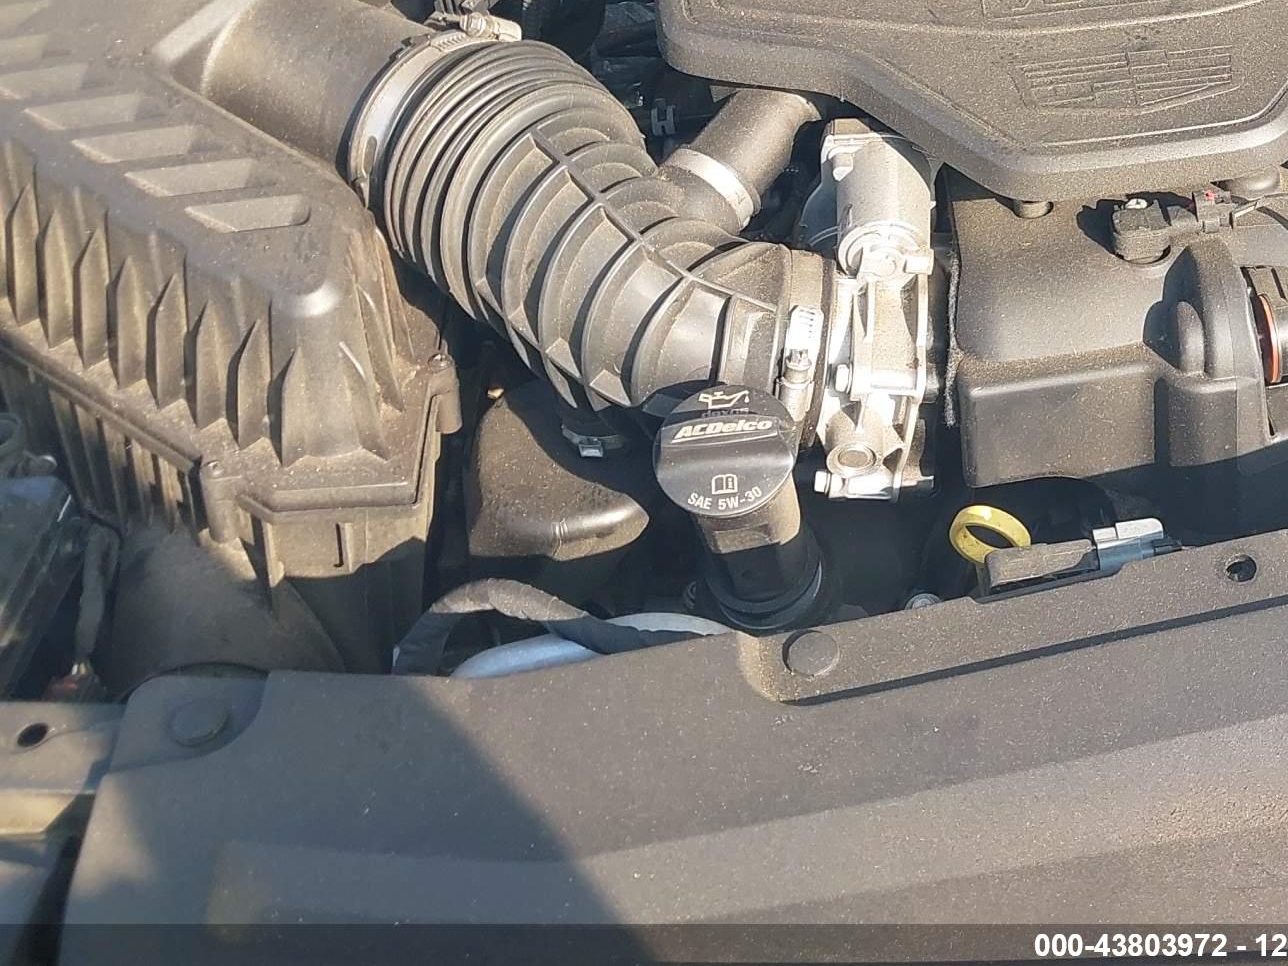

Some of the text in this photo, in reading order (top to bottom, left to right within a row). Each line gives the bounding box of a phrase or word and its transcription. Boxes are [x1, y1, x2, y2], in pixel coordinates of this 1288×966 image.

[673, 419, 773, 440] ACDelco
[687, 486, 762, 510] SAE 5W-30
